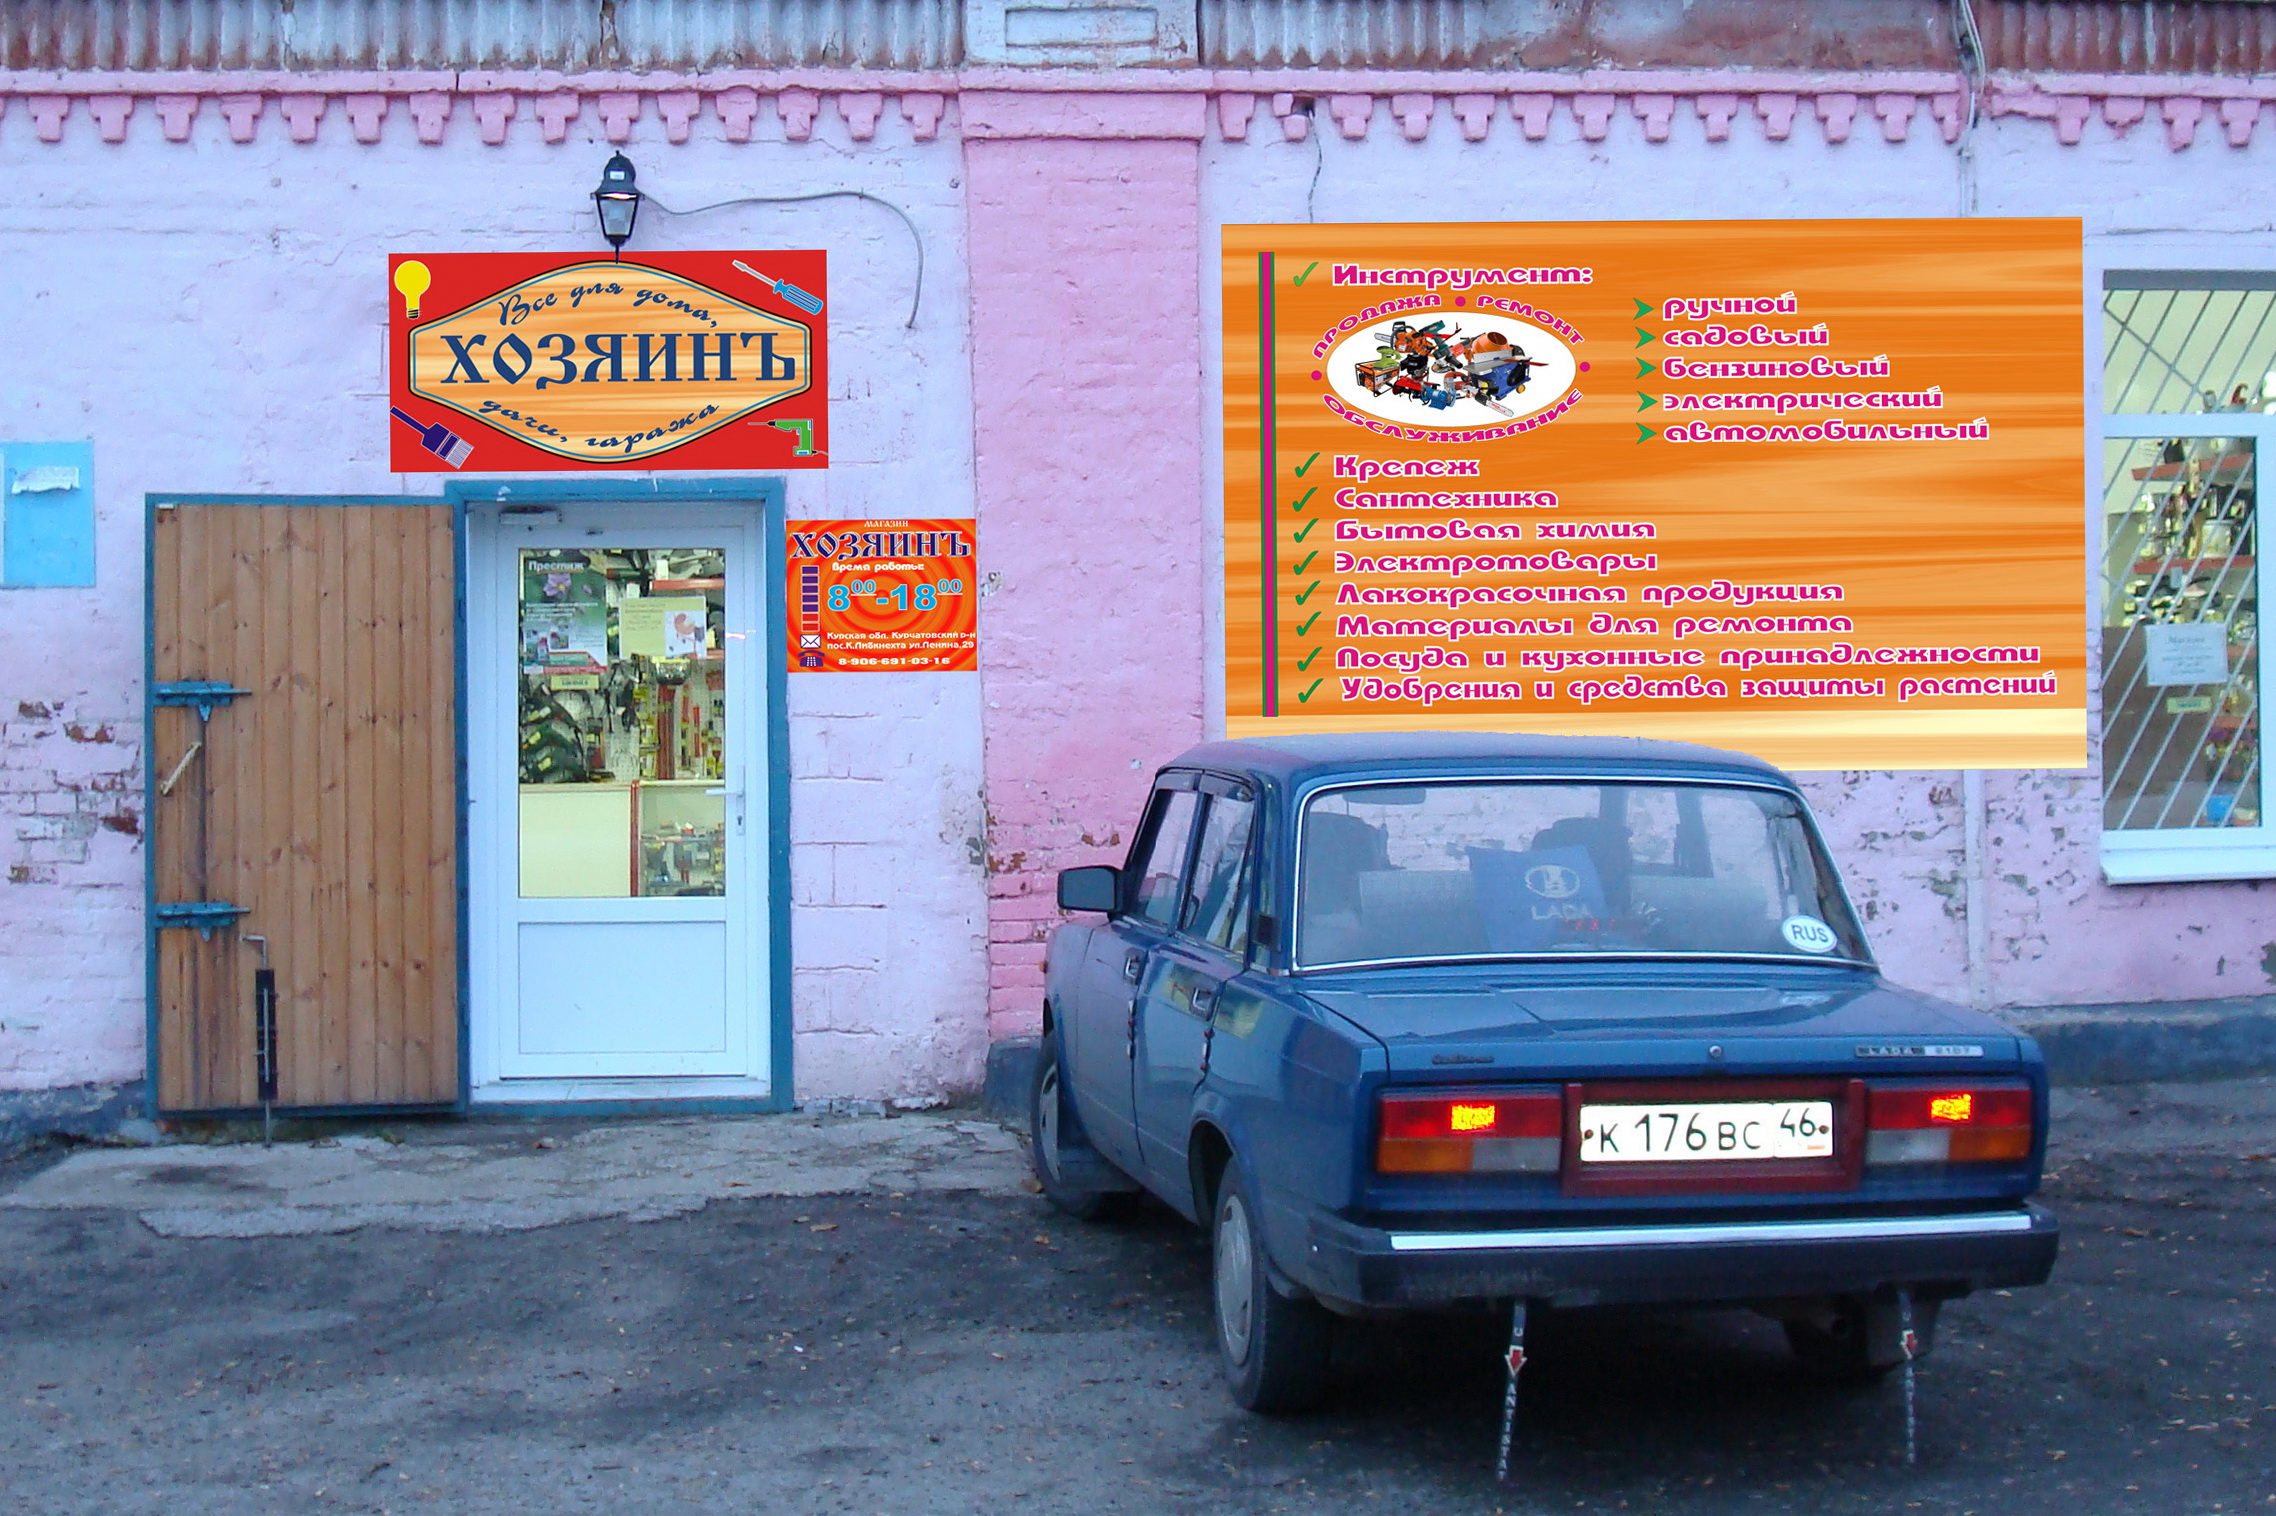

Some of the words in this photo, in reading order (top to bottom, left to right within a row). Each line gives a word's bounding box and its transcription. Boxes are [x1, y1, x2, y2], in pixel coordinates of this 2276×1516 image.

[1332, 263, 1594, 291] Инструмент:
[499, 292, 558, 326] Все
[571, 282, 625, 308] для
[636, 288, 719, 328] дома,
[1662, 290, 1798, 321] ручной
[1312, 294, 1443, 361] ПРОДАЖА
[1476, 294, 1586, 347] РЕМОНТ
[1662, 322, 1829, 348] садовый
[439, 332, 797, 390] ХОЗЯИНЪ
[1662, 353, 1891, 380] бензиновый
[1662, 385, 1944, 415] электрический
[478, 399, 569, 442] дачи,
[584, 404, 720, 454] гаража
[1322, 388, 1584, 444] ОБСЛУЖИВАНИЕ
[1663, 416, 1990, 443] автомобильный
[1334, 454, 1480, 483] Крепеж
[1334, 487, 1558, 509] Сантехника
[864, 520, 909, 528] МАГАЗИН
[1334, 518, 1521, 542] Бытовая
[1536, 521, 1656, 540] химия
[790, 531, 971, 561] ХОЗЯИНЪ
[528, 560, 585, 573] Престиж
[832, 562, 871, 573] Время
[874, 562, 925, 572] работы:
[1334, 549, 1658, 578] Электротовары
[1335, 582, 1627, 610] Лакокрасочная
[1642, 580, 1844, 608] продукция
[827, 632, 866, 641] Курская
[891, 631, 959, 640] Курчатовский
[1336, 614, 1574, 641] Материалы
[1588, 612, 1659, 635] для
[1673, 614, 1853, 640] ремонта
[838, 657, 951, 666] 8-906-691-03-16
[1336, 645, 1469, 674] Посуда
[1483, 650, 1506, 668] и
[1520, 648, 1705, 673] кухонные
[1719, 642, 2041, 671] принадлежности
[1341, 676, 1522, 707] Удобрения
[1534, 680, 1555, 699] и
[1567, 673, 1728, 705] средства
[1740, 677, 1885, 699] защиты
[1898, 669, 2058, 702] растений
[1791, 924, 1829, 943] RUS
[1780, 1107, 1817, 1138] 46
